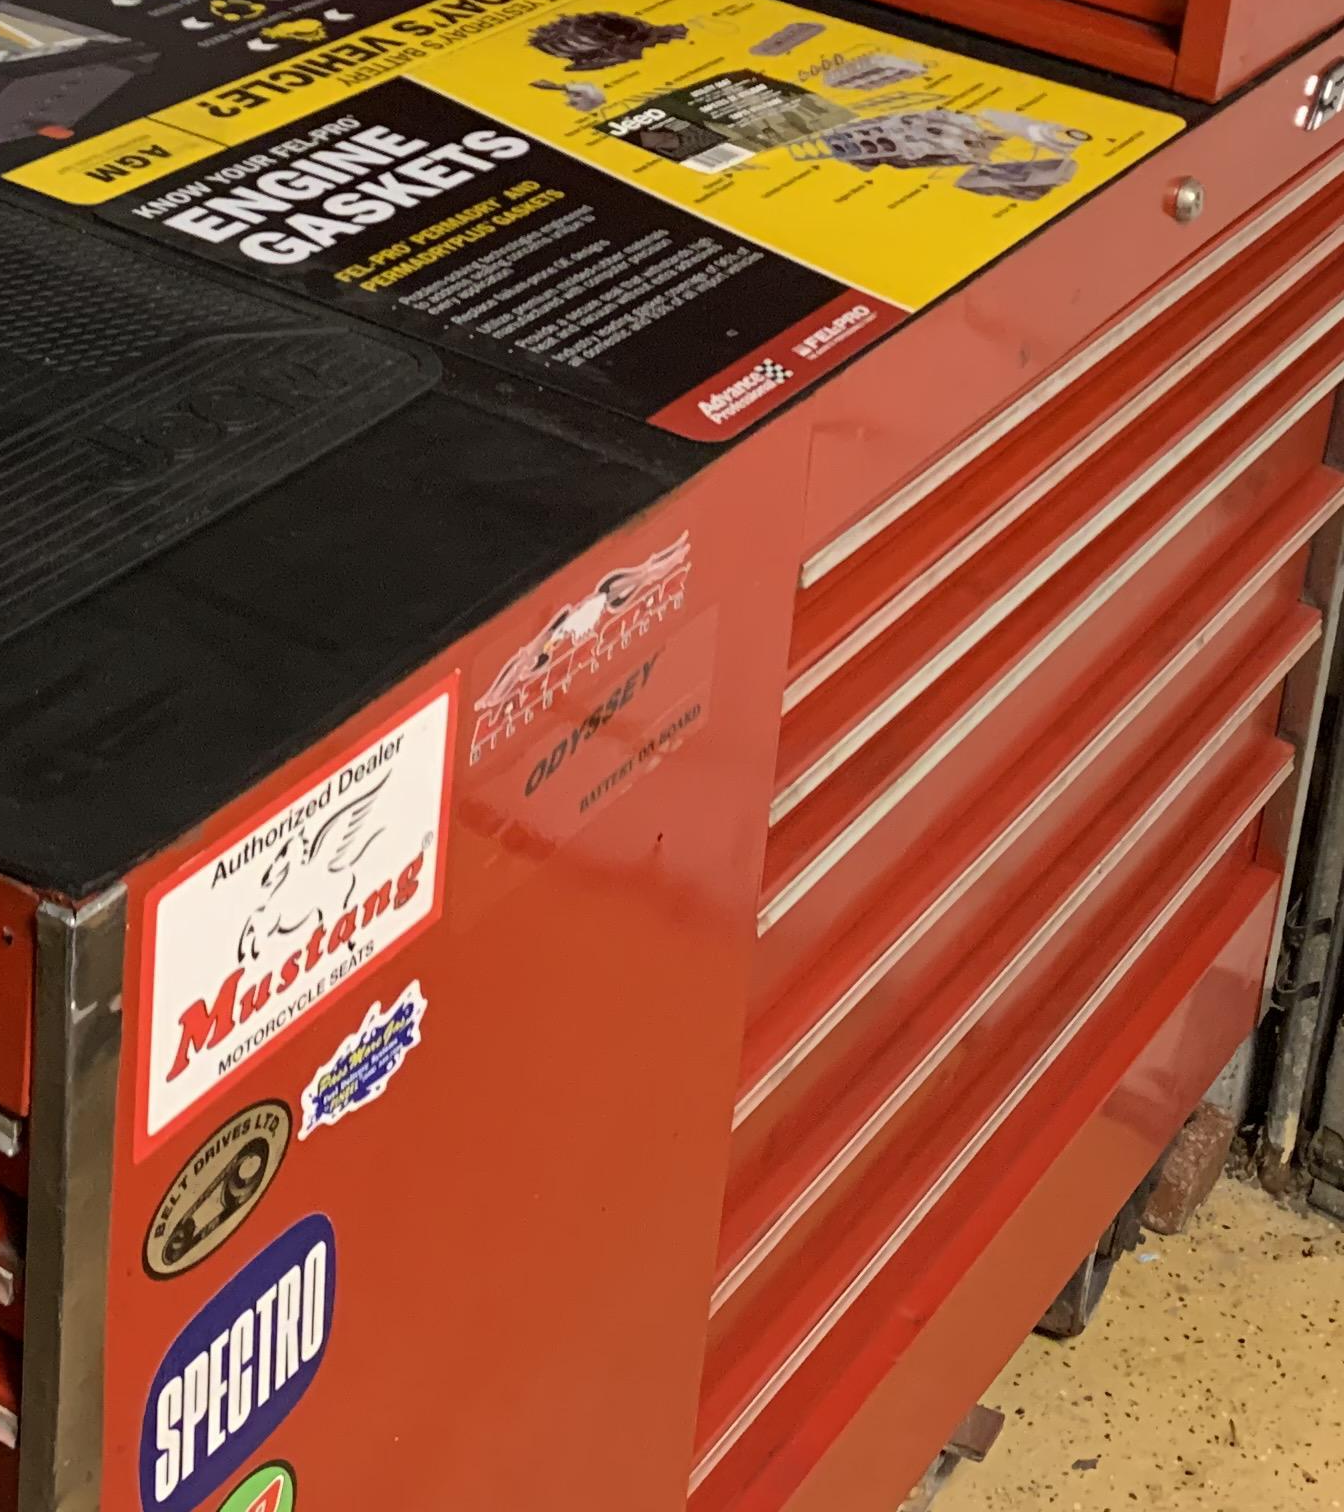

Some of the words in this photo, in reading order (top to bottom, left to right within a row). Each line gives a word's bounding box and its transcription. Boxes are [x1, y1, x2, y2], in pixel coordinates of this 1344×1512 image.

[190, 34, 404, 116] VEHICLE?
[330, 47, 429, 86] BATTERY
[418, 1, 542, 49] YESTERDAY'S
[83, 144, 178, 182] AGM
[130, 182, 216, 218] KNOW
[205, 154, 279, 184] YOUR
[267, 117, 364, 157] FEL-PRO
[598, 105, 670, 137] Jeep
[162, 128, 428, 240] ENGINE
[229, 131, 534, 265] GASKETS
[409, 199, 503, 243] PERMADRY
[499, 179, 544, 199] AND
[359, 224, 497, 290] PERMADRYPLUS
[489, 188, 567, 225] GASKETS
[800, 305, 873, 347] FEL-PRO
[691, 371, 767, 414] Advance
[525, 649, 660, 796] ODYSSEY
[211, 781, 331, 887] Authorized
[339, 734, 404, 808] Dealer
[166, 849, 426, 1083] Mustang
[218, 977, 327, 1075] MOTORCYCLE
[329, 940, 376, 986] SEATS
[154, 1174, 190, 1238] BELT
[193, 1117, 252, 1172] DRIVES
[155, 1240, 327, 1503] SPECTRO
